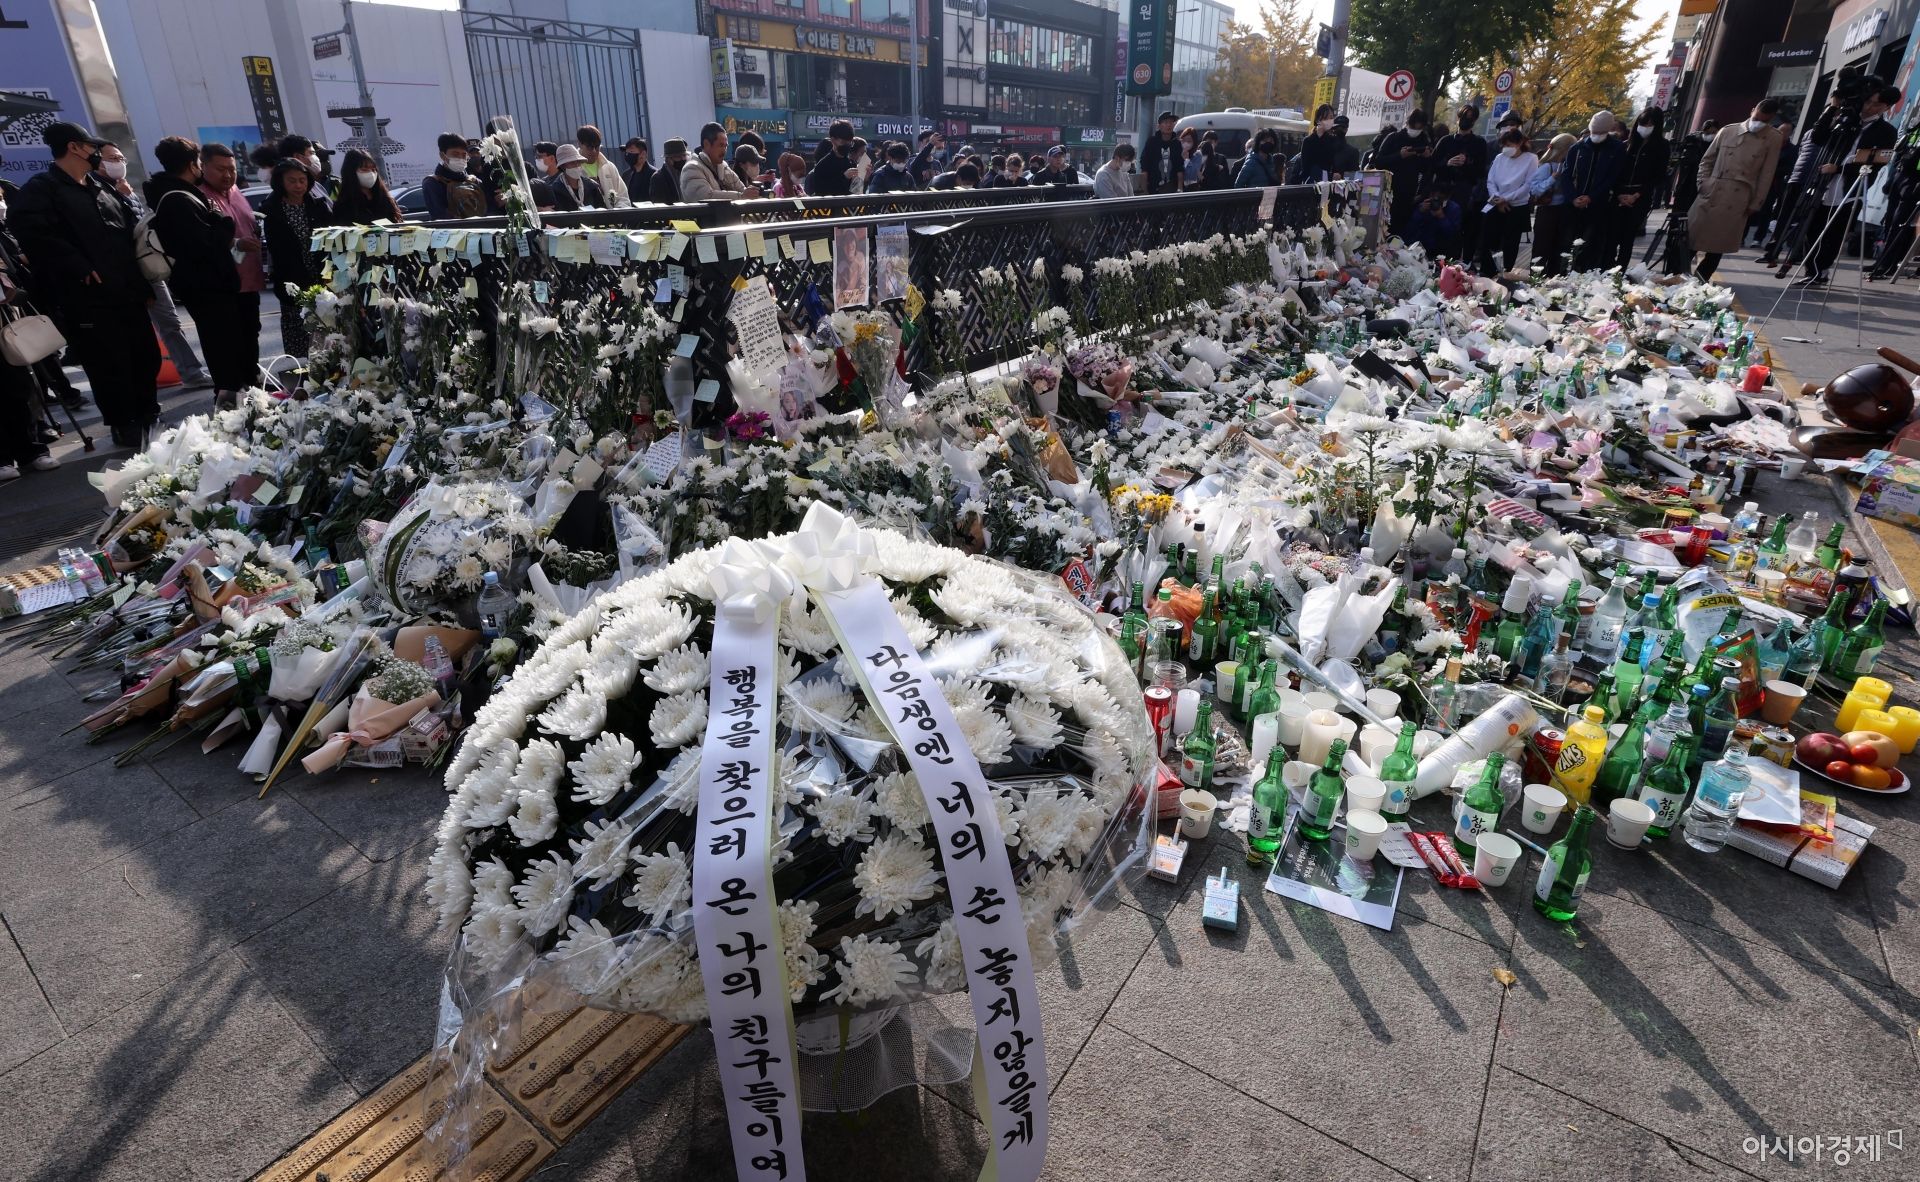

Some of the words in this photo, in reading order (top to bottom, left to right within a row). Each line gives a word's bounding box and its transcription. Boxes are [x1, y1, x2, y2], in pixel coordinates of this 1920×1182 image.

[808, 31, 839, 50] 이바돔
[263, 78, 271, 88] 4
[1135, 70, 1149, 78] 630
[1498, 76, 1509, 88] 50
[265, 96, 281, 131] 이태원
[1115, 81, 1123, 121] ALPEDO
[878, 124, 901, 134] EDIYA
[1081, 128, 1104, 139] ALPEDO
[717, 665, 762, 749] 행복을
[866, 645, 954, 765] 다음생엔
[936, 781, 986, 863] 너의
[962, 886, 1006, 924] 손
[709, 760, 760, 860] 찾으러
[1658, 797, 1676, 821] 참이슬
[705, 877, 757, 915] 온
[716, 931, 768, 999] 나의
[728, 1015, 787, 1182] 친구들이여
